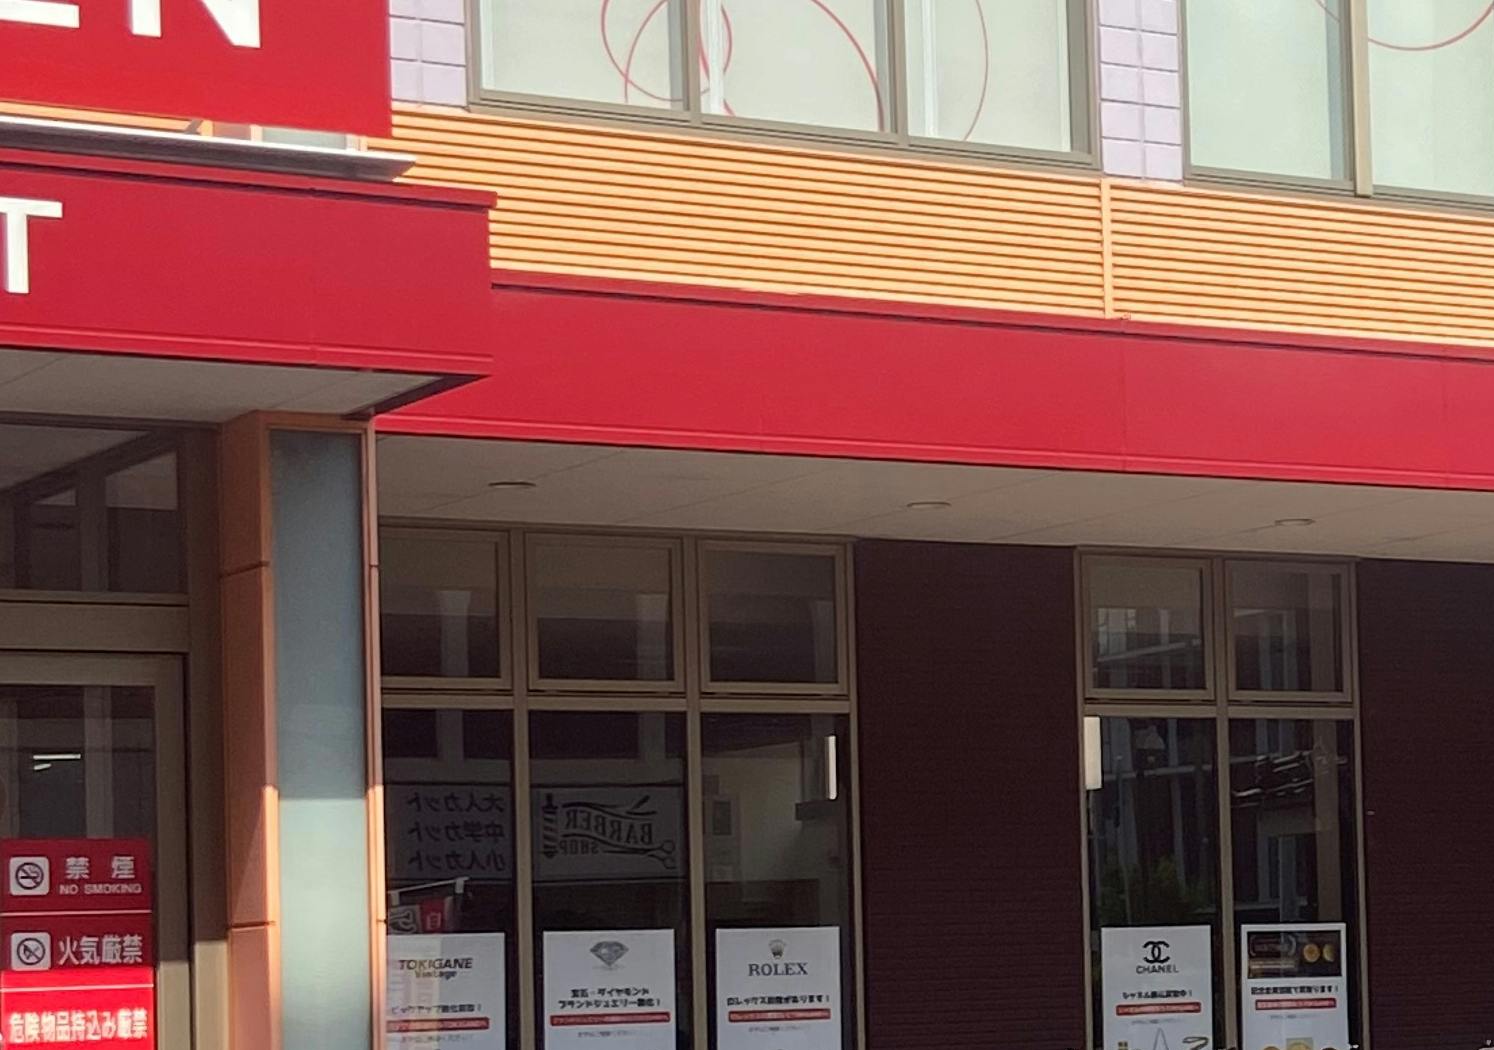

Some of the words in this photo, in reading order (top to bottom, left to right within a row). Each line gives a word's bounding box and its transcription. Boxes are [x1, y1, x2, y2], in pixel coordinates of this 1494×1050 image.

[59, 884, 79, 895] NO
[84, 882, 143, 895] SMOKING
[58, 934, 143, 966] 火気厳禁
[398, 957, 475, 971] TOKIGANE
[748, 962, 809, 977] ROLEX
[1135, 964, 1179, 975] CHANEL
